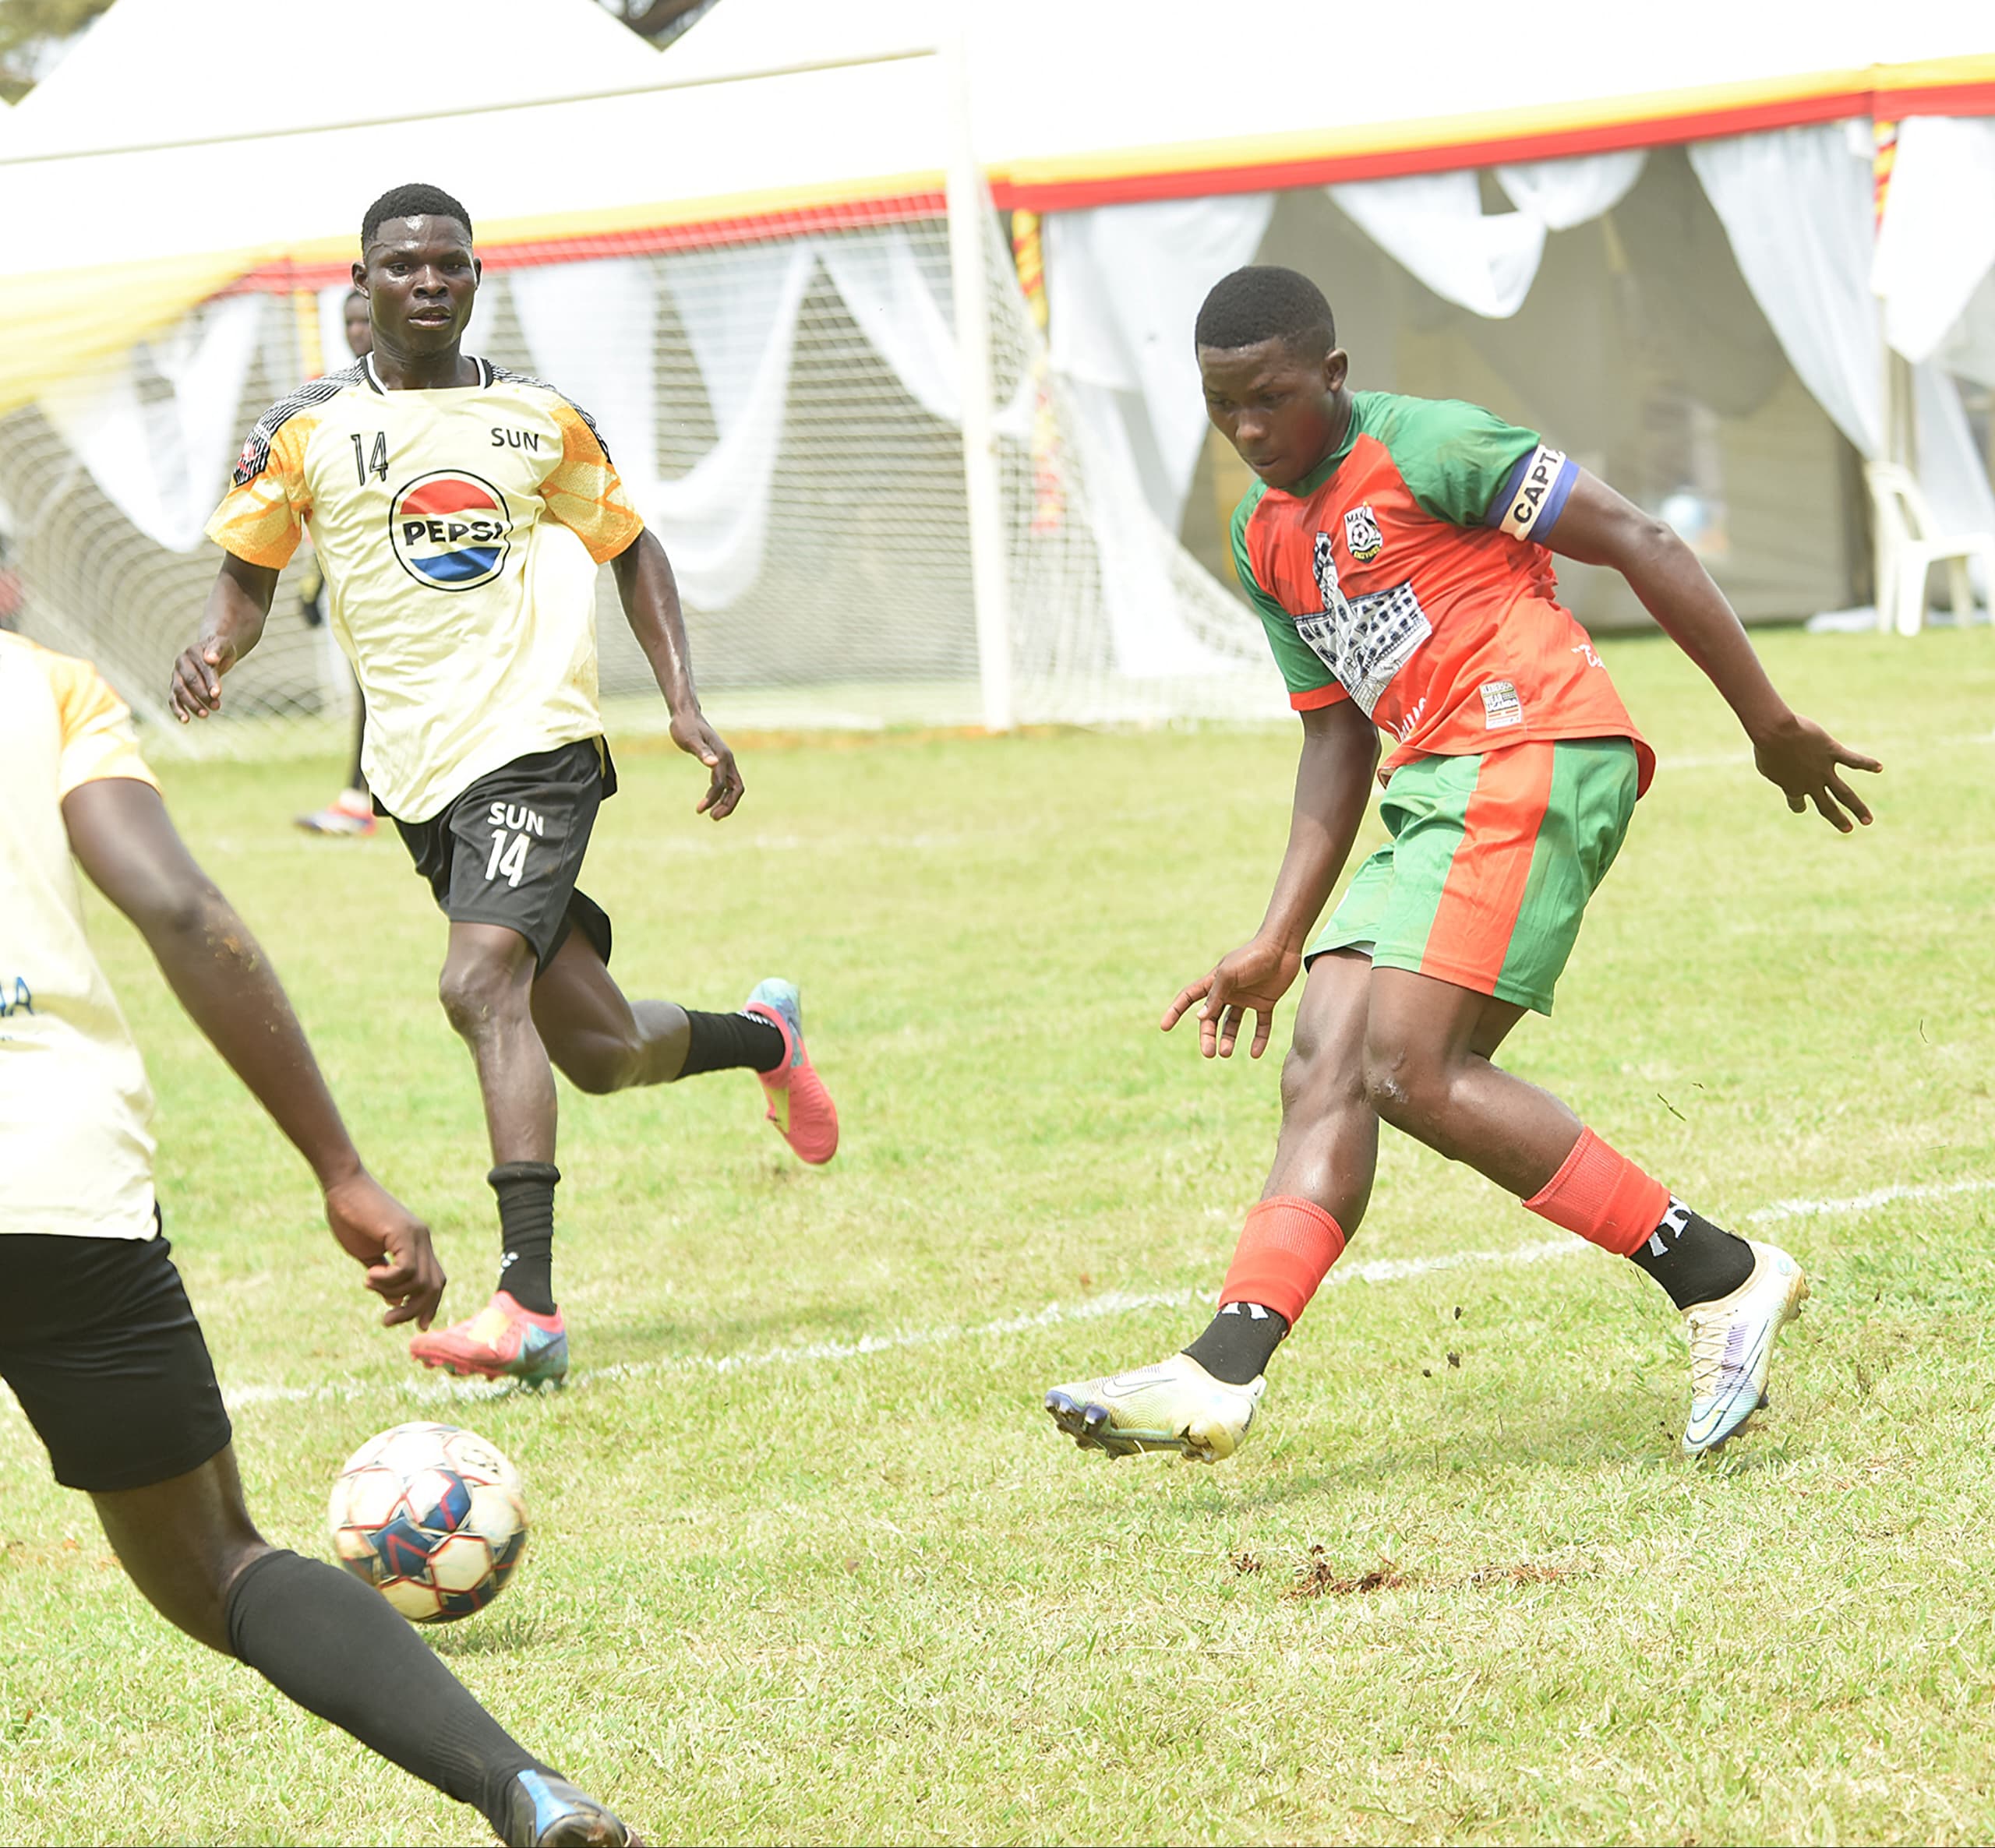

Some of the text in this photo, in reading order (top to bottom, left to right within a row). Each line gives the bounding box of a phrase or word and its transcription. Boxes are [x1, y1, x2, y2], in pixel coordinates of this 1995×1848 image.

[351, 431, 389, 486] 14
[491, 428, 538, 452] SUN
[1513, 450, 1561, 524] CAPT
[402, 520, 502, 546] PEPSI
[487, 802, 544, 837] SUN
[485, 829, 531, 887] 14
